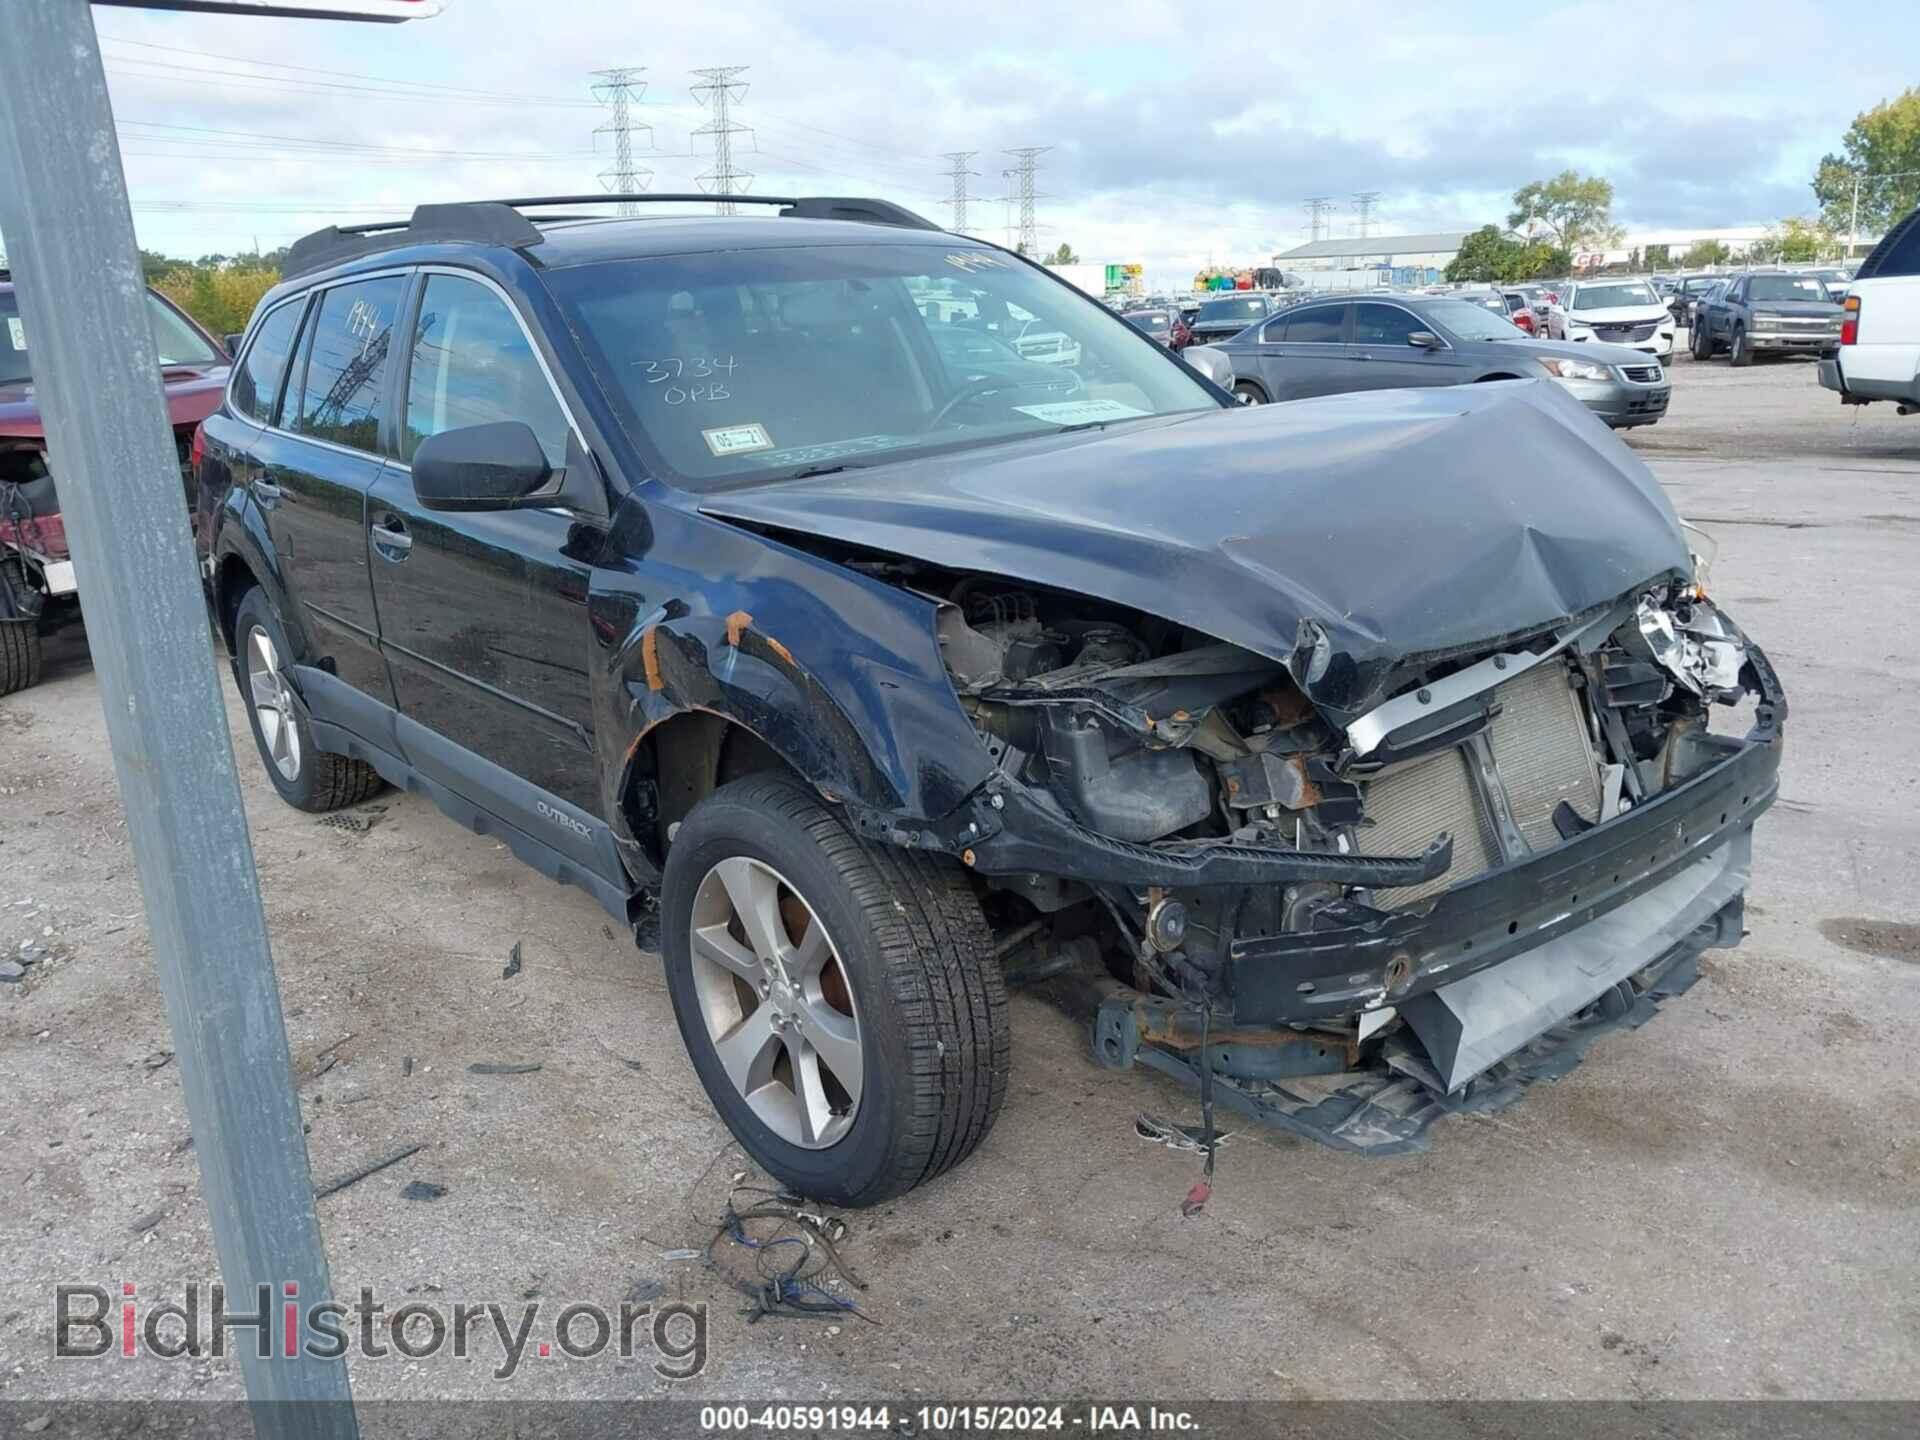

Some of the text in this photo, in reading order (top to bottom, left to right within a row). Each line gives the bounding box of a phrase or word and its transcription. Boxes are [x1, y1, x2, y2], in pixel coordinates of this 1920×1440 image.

[345, 299, 381, 361] 1944
[631, 354, 739, 384] 3734
[536, 801, 592, 841] OUTBACK
